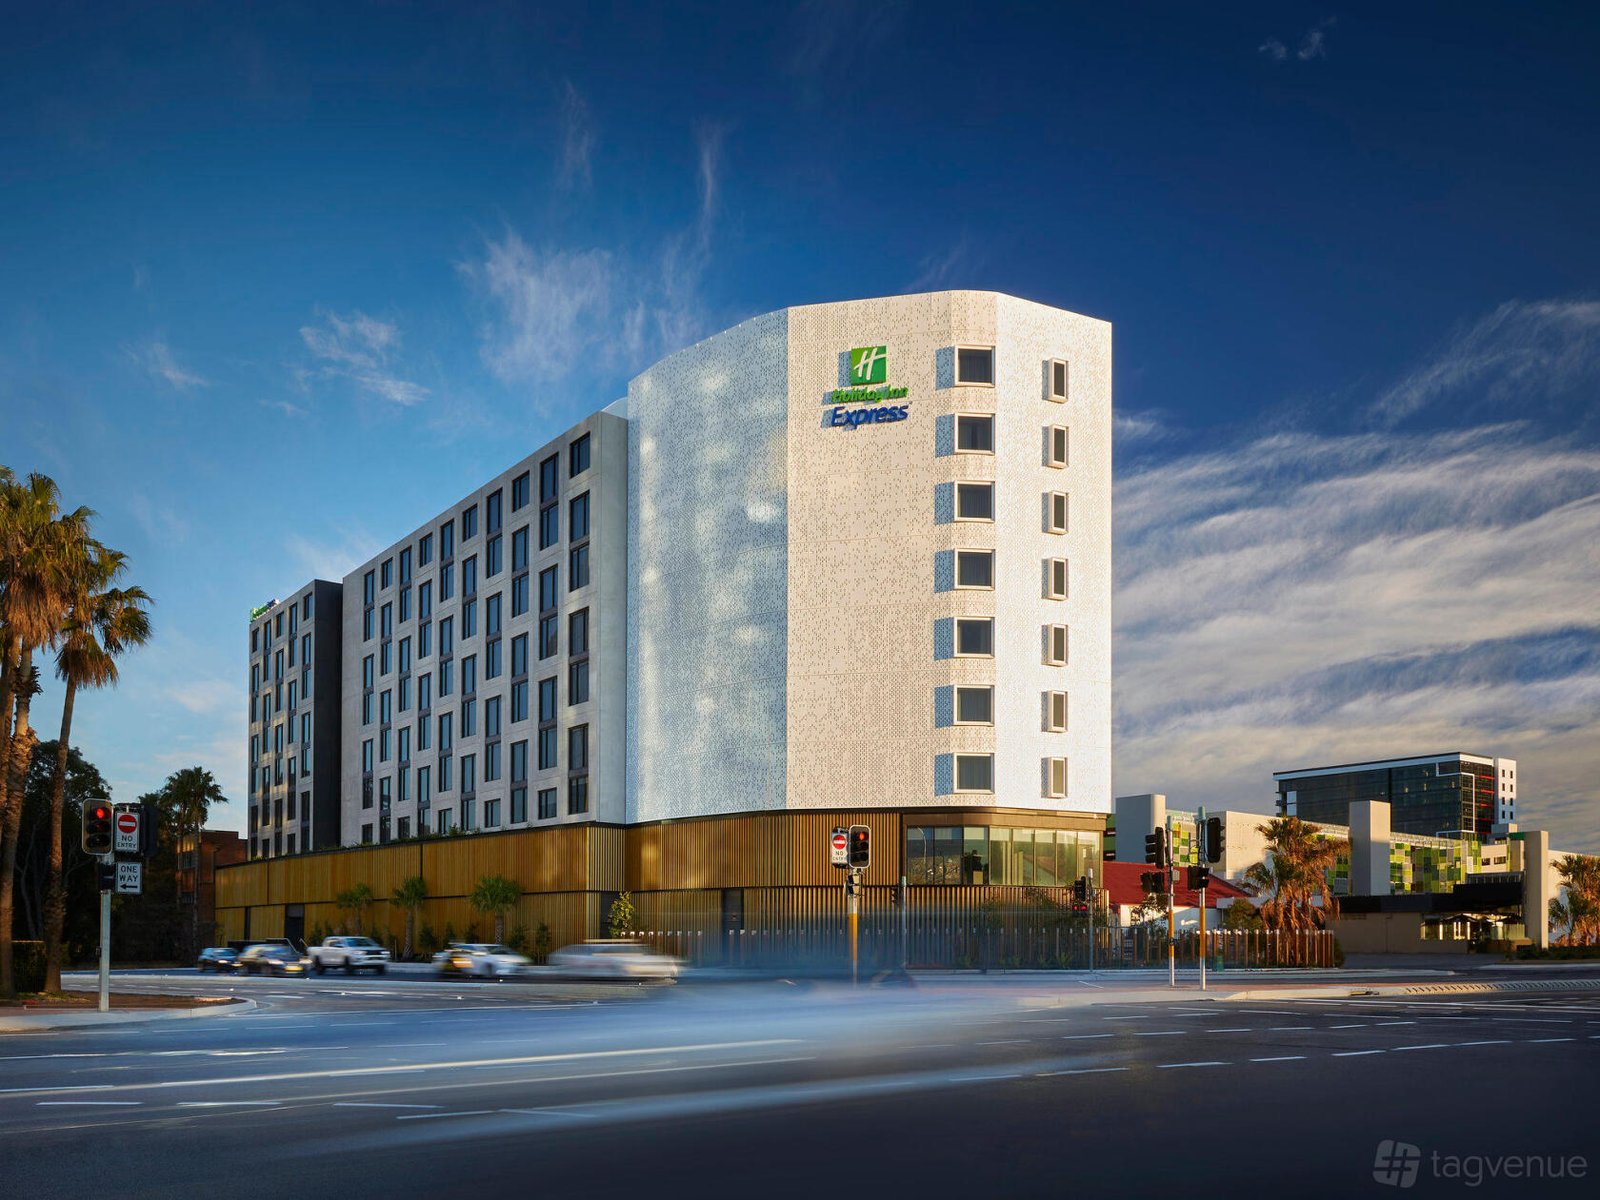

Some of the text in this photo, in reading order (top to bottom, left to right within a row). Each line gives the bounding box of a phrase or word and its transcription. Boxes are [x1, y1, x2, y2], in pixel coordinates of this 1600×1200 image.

[832, 384, 908, 403] Holiday Inn
[831, 406, 909, 429] Express
[120, 865, 138, 873] ONE
[119, 874, 139, 882] WAY
